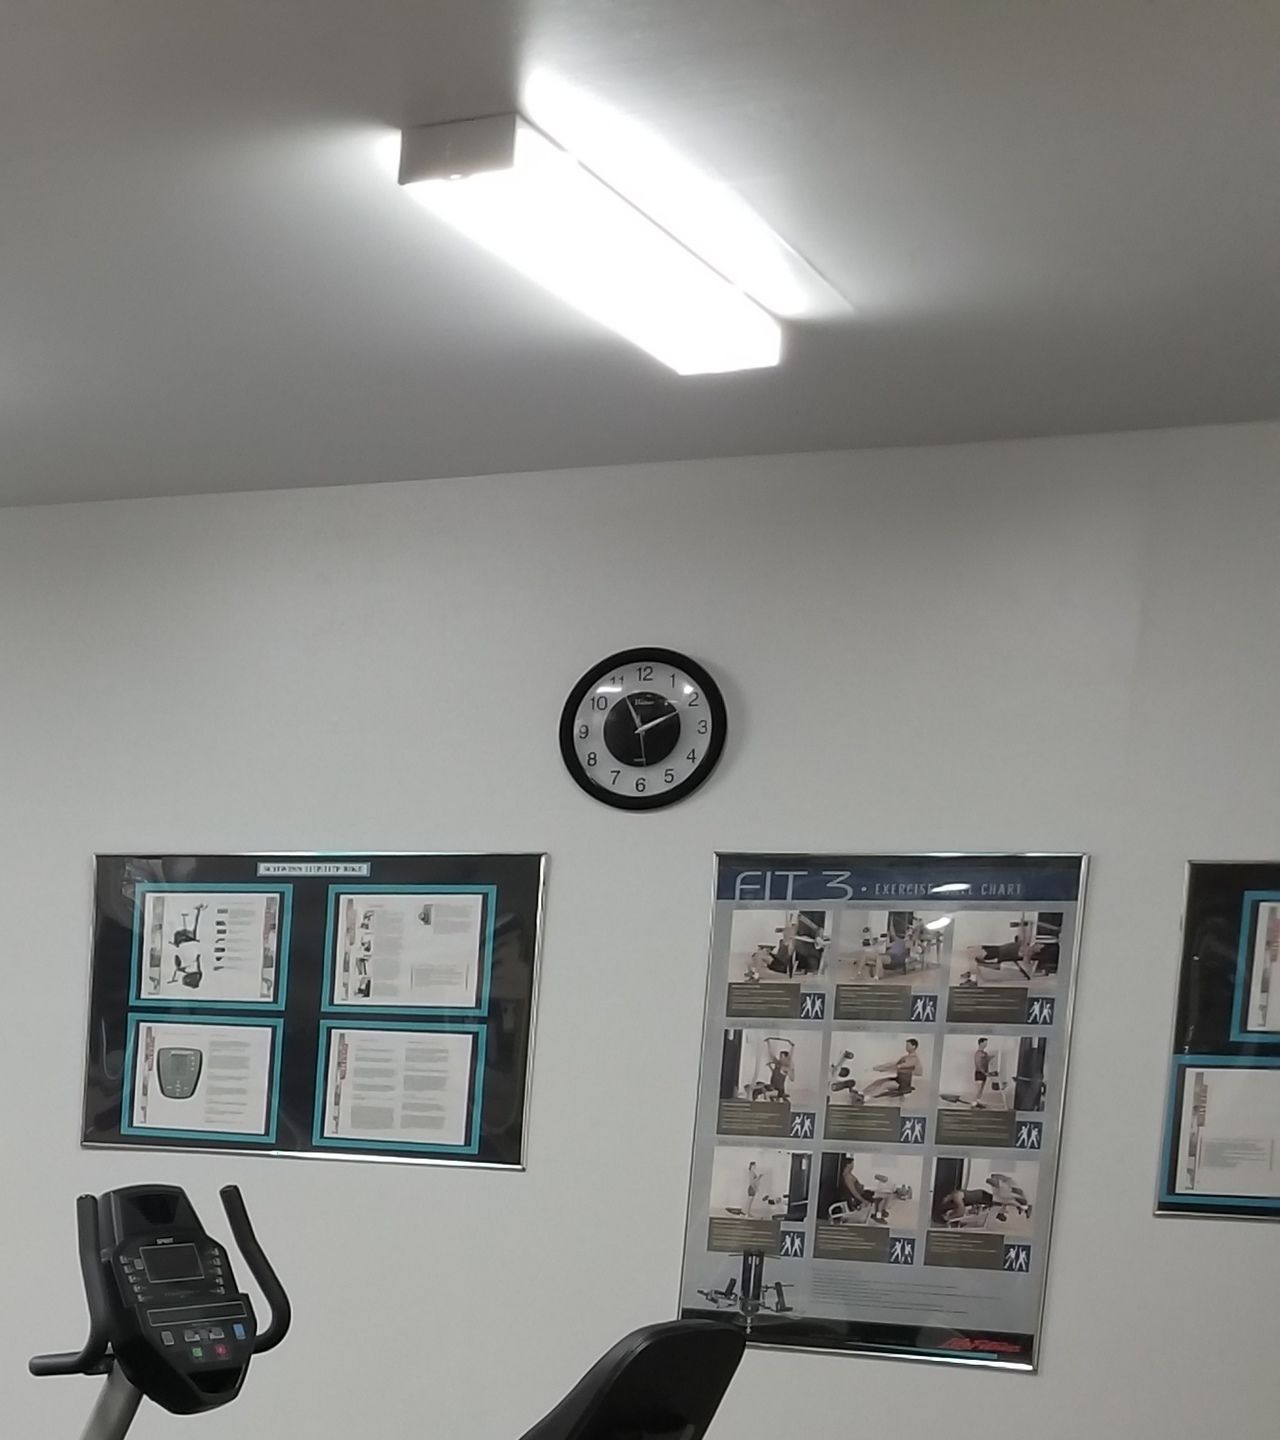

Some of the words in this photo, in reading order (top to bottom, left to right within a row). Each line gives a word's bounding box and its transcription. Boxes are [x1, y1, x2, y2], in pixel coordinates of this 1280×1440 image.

[610, 676, 624, 685] 11
[636, 666, 654, 681] 12
[669, 674, 676, 688] 1
[591, 696, 608, 711] 10
[688, 692, 699, 707] 2
[579, 725, 589, 739] 9
[697, 720, 708, 735] 3
[587, 752, 597, 766] 8
[686, 749, 696, 763] 4
[610, 770, 621, 785] 7
[664, 769, 674, 783] 5
[635, 777, 646, 792] 6
[735, 870, 808, 900] FIT
[822, 871, 854, 900] 3
[874, 882, 934, 896] EXERCISE
[980, 883, 1022, 896] CHART
